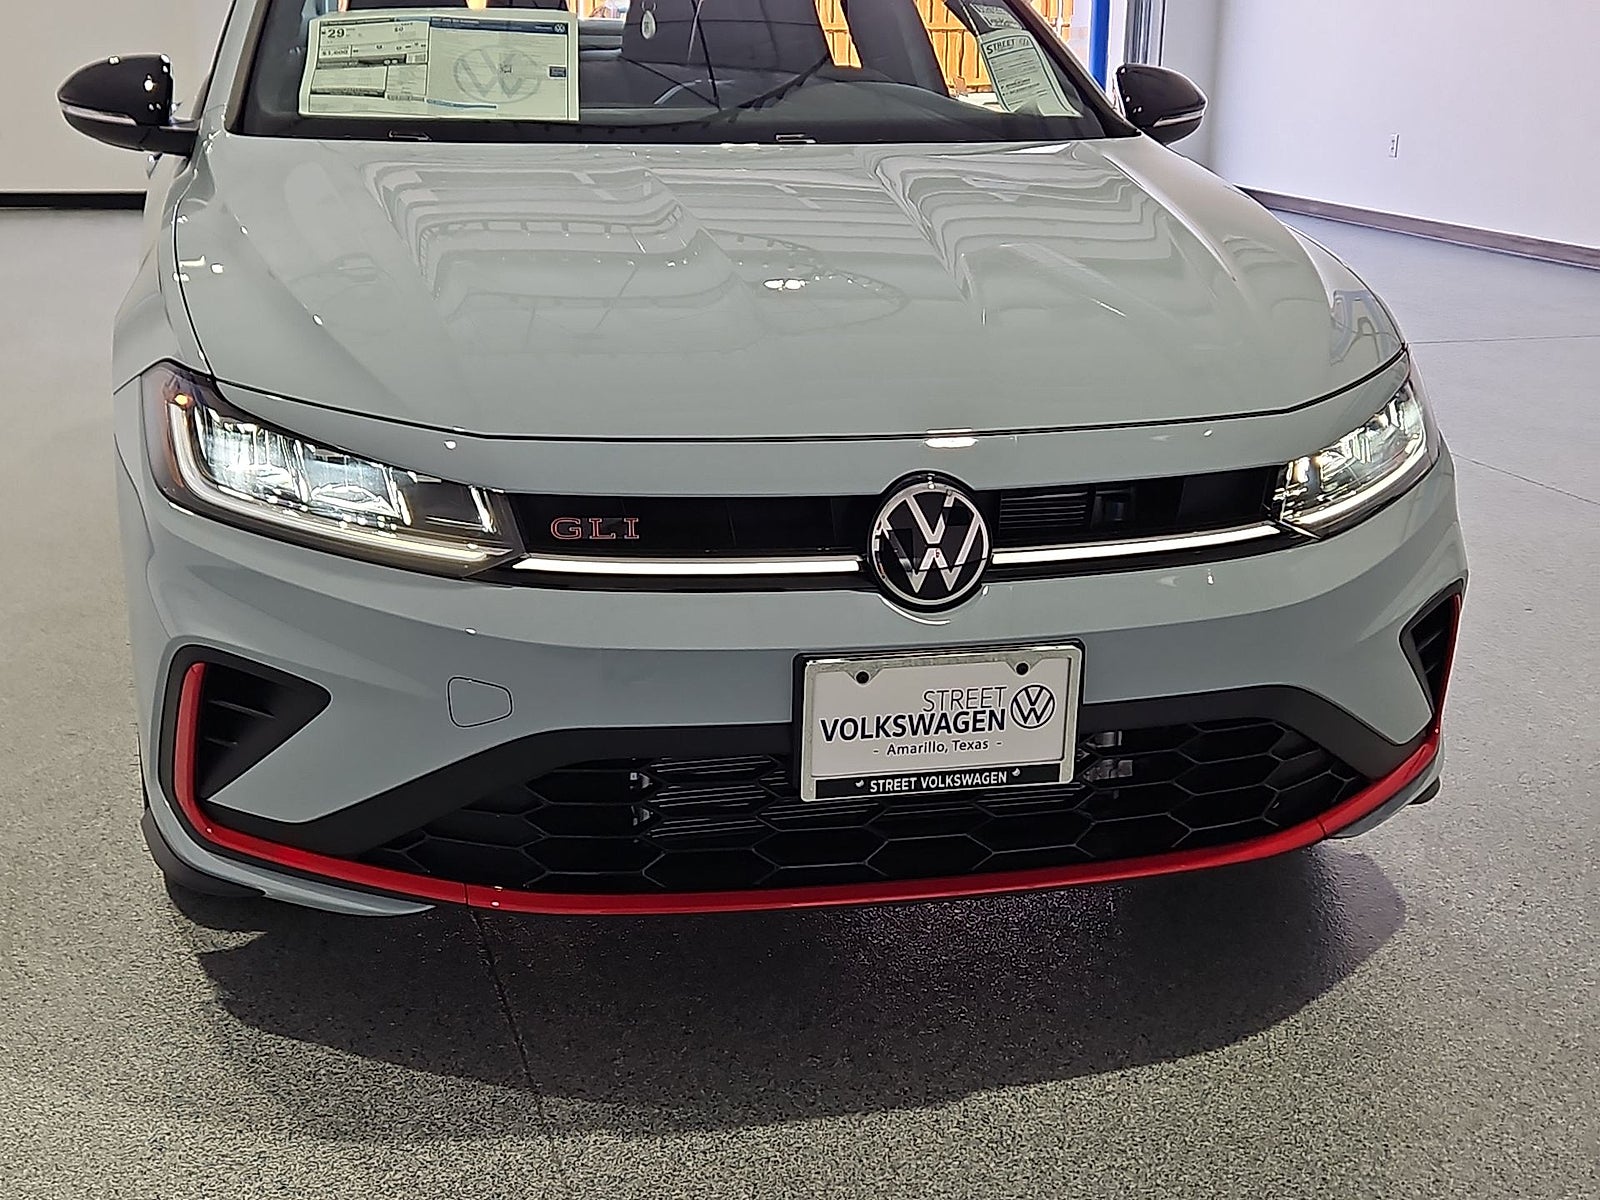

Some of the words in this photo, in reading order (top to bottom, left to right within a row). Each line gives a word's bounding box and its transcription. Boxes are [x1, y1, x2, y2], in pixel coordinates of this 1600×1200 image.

[327, 28, 345, 39] 29
[550, 517, 640, 540] GLI
[923, 686, 1007, 712] STREET
[820, 708, 1006, 742] VOLKSWAGEN
[886, 740, 949, 756] Amarillo,
[952, 739, 989, 752] Texas
[869, 776, 917, 793] STREET
[920, 771, 1007, 789] VOLKSWAGEN
